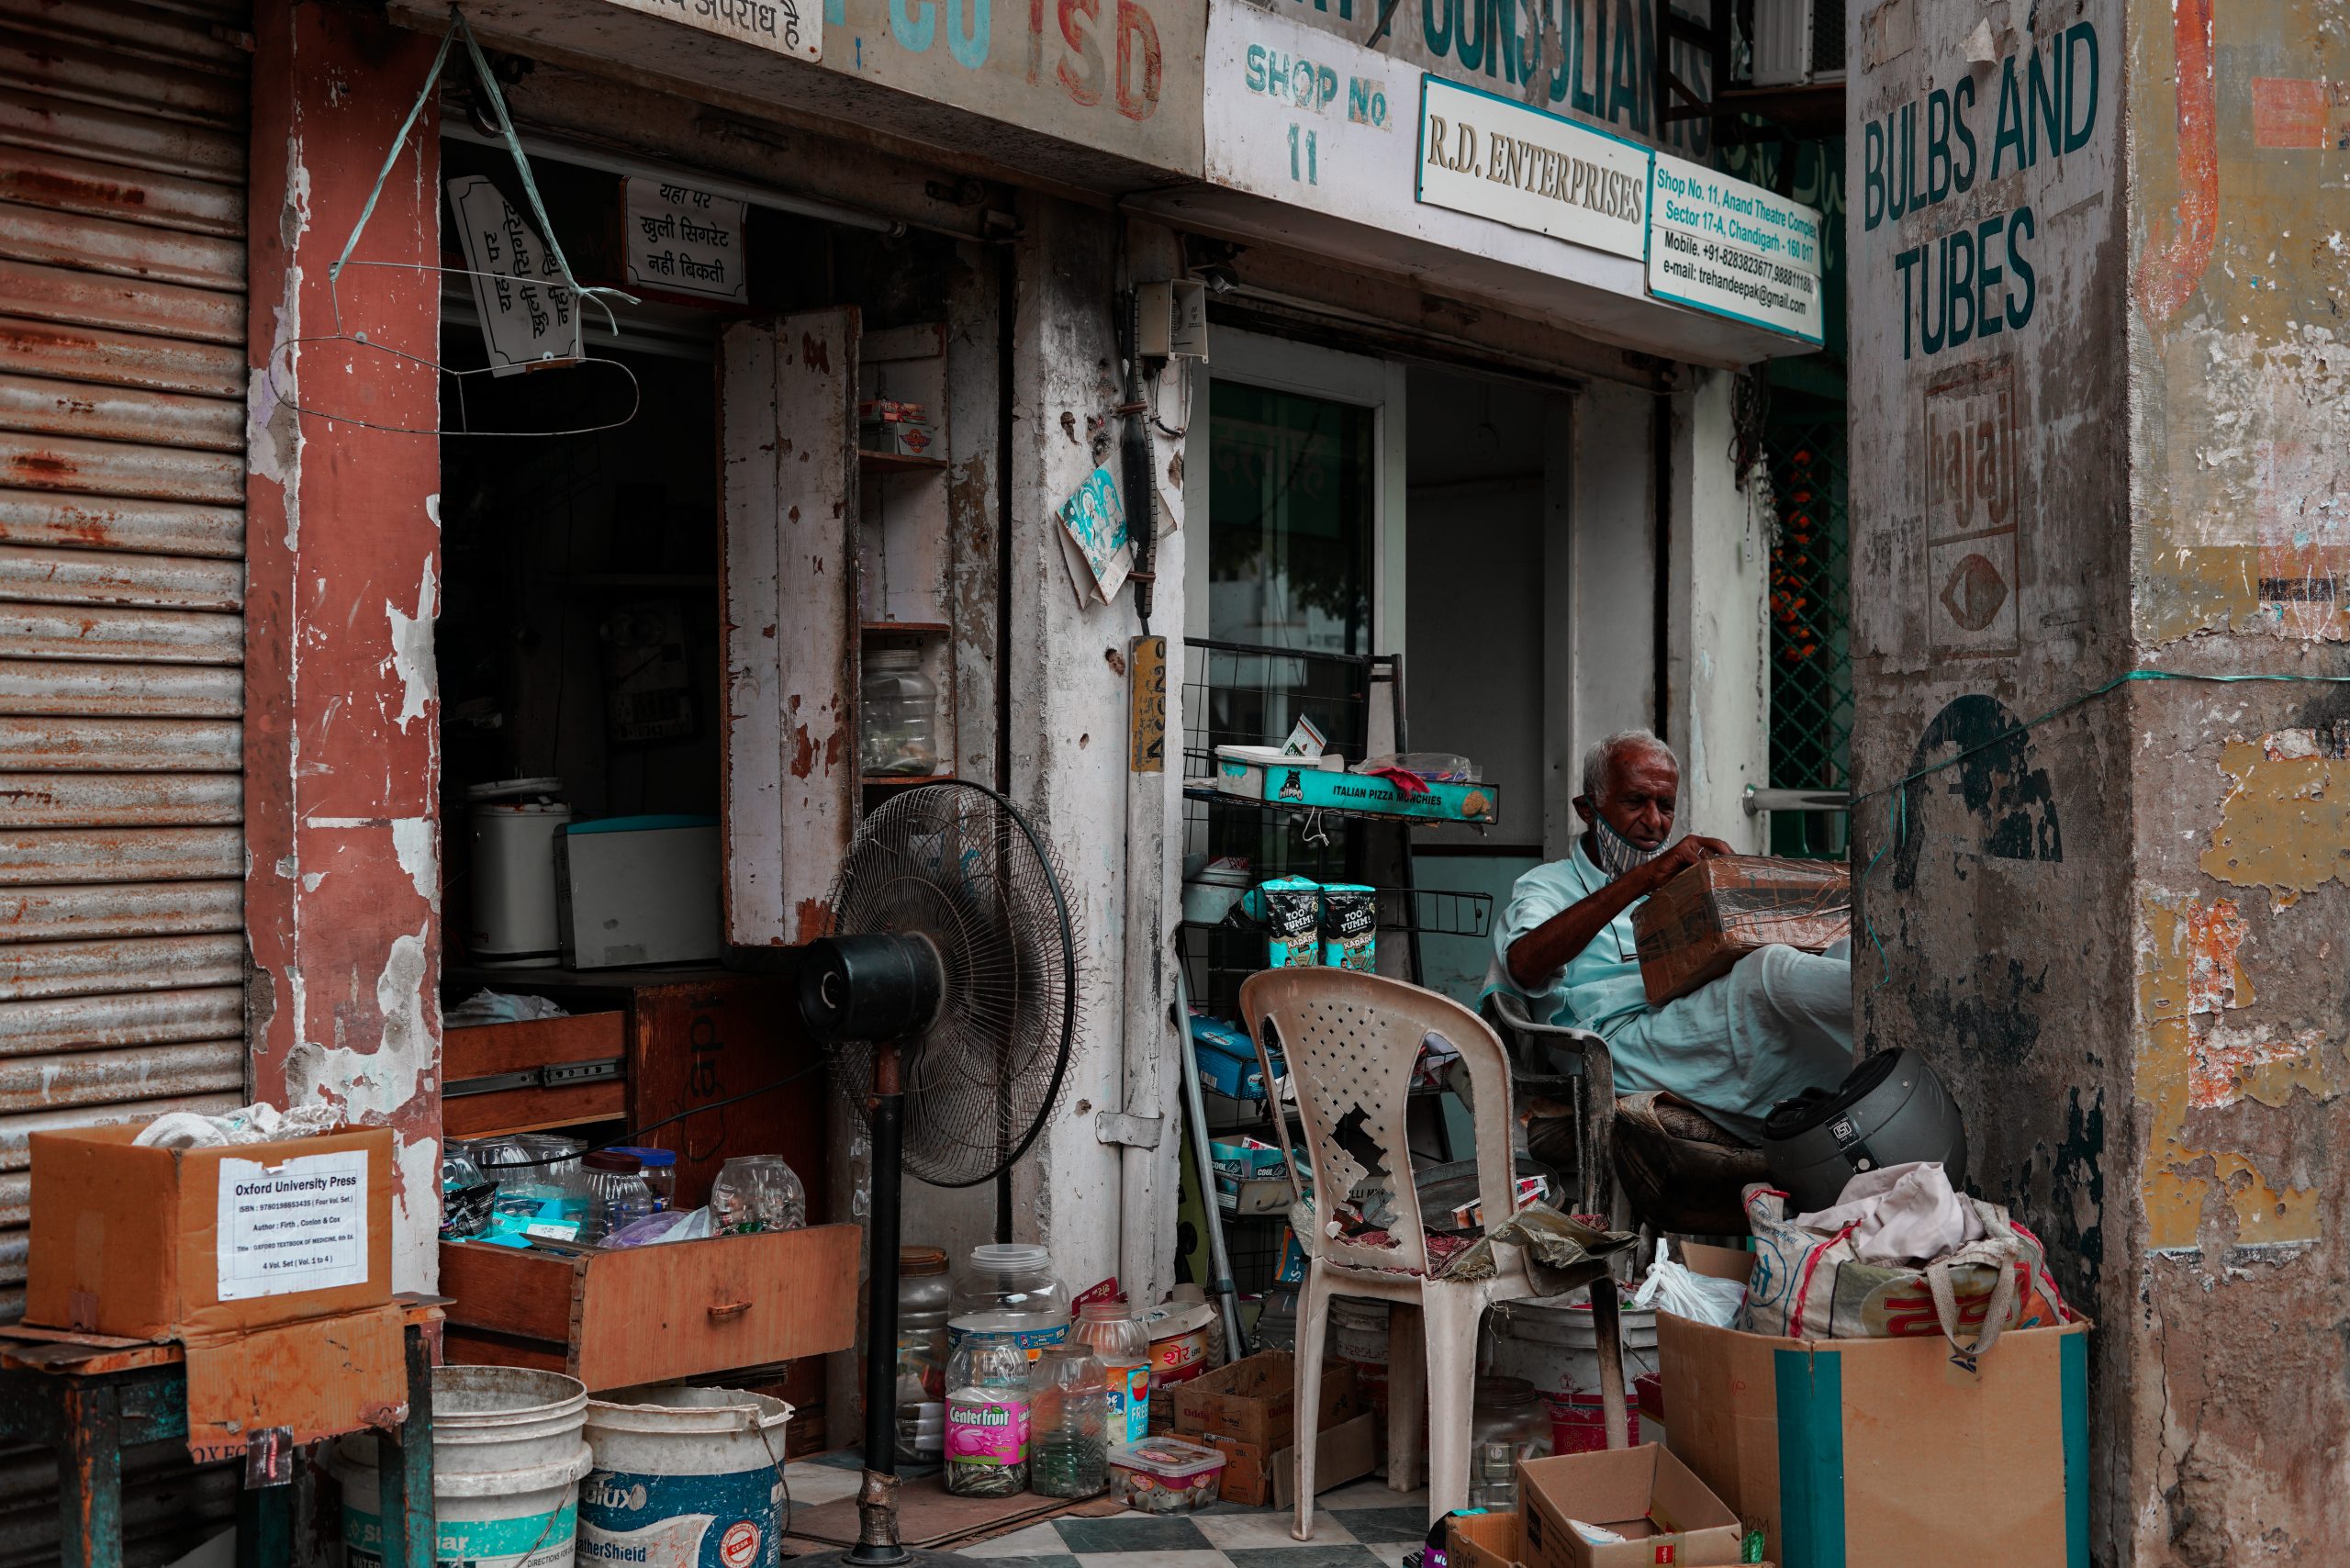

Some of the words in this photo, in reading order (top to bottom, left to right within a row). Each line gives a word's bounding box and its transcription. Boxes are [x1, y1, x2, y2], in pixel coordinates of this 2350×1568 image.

[1246, 43, 1339, 111] SHOP
[1863, 73, 1978, 233] BULBS
[1989, 20, 2100, 181] AND
[1287, 121, 1319, 186] 11
[1428, 113, 1482, 179] R.D.
[1486, 131, 1644, 226] ENTERPRISES
[1657, 168, 1686, 198] Shop
[1687, 177, 1705, 202] No.
[1707, 185, 1721, 209] 11,
[1722, 189, 1753, 218] Anand
[1754, 198, 1786, 228] Theatre
[640, 215, 676, 244] खुली
[678, 214, 730, 249] सिगरेट
[1664, 230, 1700, 258] Mobile.
[1666, 199, 1700, 228] Sector
[1702, 210, 1727, 240] 17-A,
[1729, 219, 1781, 252] Chandigarh
[1787, 238, 1801, 259] 160
[1801, 244, 1814, 264] 017
[483, 230, 502, 263] पर
[646, 251, 676, 276] नहीं
[678, 252, 725, 285] बिकती
[1663, 259, 1697, 282] e-mail:
[1699, 267, 1807, 316] trehandeepak@gmail.com
[1895, 206, 2037, 361] TUBES
[520, 285, 546, 340] खुली
[1928, 392, 2011, 530] bajaj
[1278, 787, 1304, 801] HIPPO
[1333, 784, 1367, 799] ITALIAN
[1369, 790, 1393, 801] PIZZA
[1396, 791, 1442, 806] MUNCHIES
[1283, 914, 1315, 931] YUMM!
[1286, 908, 1306, 922] TOO
[1340, 915, 1371, 932] YUMM!
[1344, 909, 1365, 922] TOO
[1211, 1161, 1226, 1172] COOL
[1257, 1168, 1273, 1177] COOL
[236, 1182, 272, 1196] Oxford
[275, 1178, 328, 1193] University
[330, 1176, 357, 1188] Press
[341, 1195, 351, 1204] Set
[253, 1224, 275, 1232] Author
[277, 1240, 304, 1249] TEXTBOOK
[1162, 1344, 1192, 1366] शेर
[528, 1551, 560, 1568] DIRECTIONS
